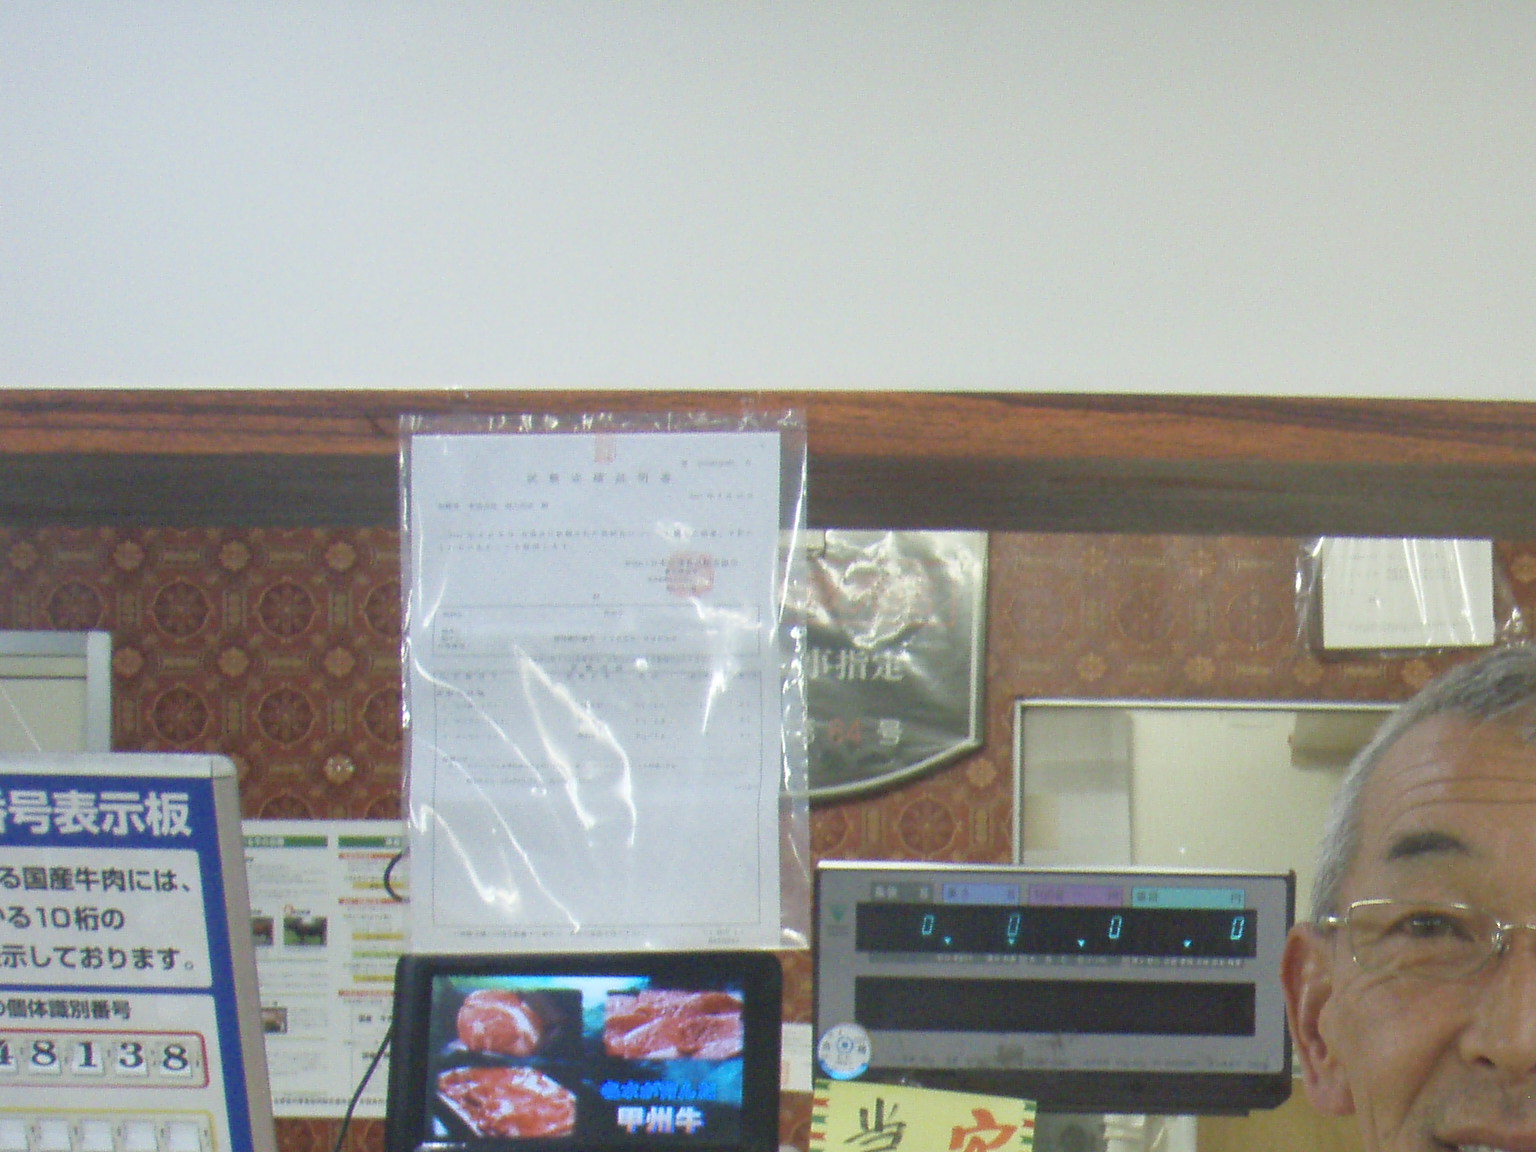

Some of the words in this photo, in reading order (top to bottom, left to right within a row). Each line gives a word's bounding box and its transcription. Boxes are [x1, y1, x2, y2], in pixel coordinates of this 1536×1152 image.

[0, 789, 192, 837] 号表示板
[921, 914, 935, 936] 0
[1008, 913, 1021, 937] 0
[1109, 915, 1123, 940] 0
[1230, 916, 1246, 941] 0
[0, 998, 133, 1020] 個体識別番号
[617, 1105, 703, 1133] 甲州牛
